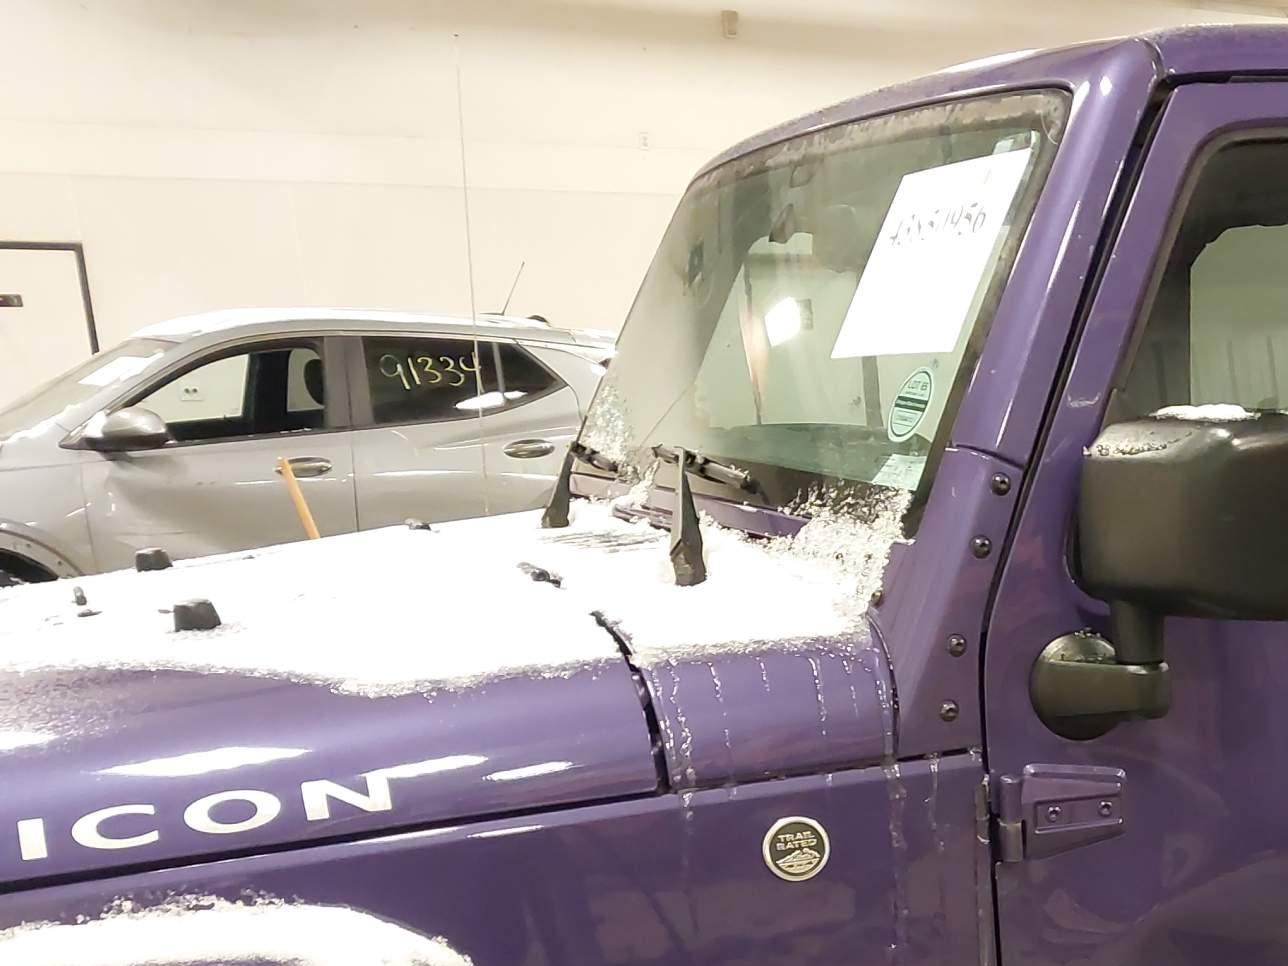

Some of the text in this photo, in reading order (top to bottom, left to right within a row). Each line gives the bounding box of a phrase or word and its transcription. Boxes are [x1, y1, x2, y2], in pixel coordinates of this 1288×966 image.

[379, 351, 485, 392] 91334
[17, 776, 393, 862] ICON
[776, 839, 817, 851] RATED
[777, 831, 816, 842] TRAIL
